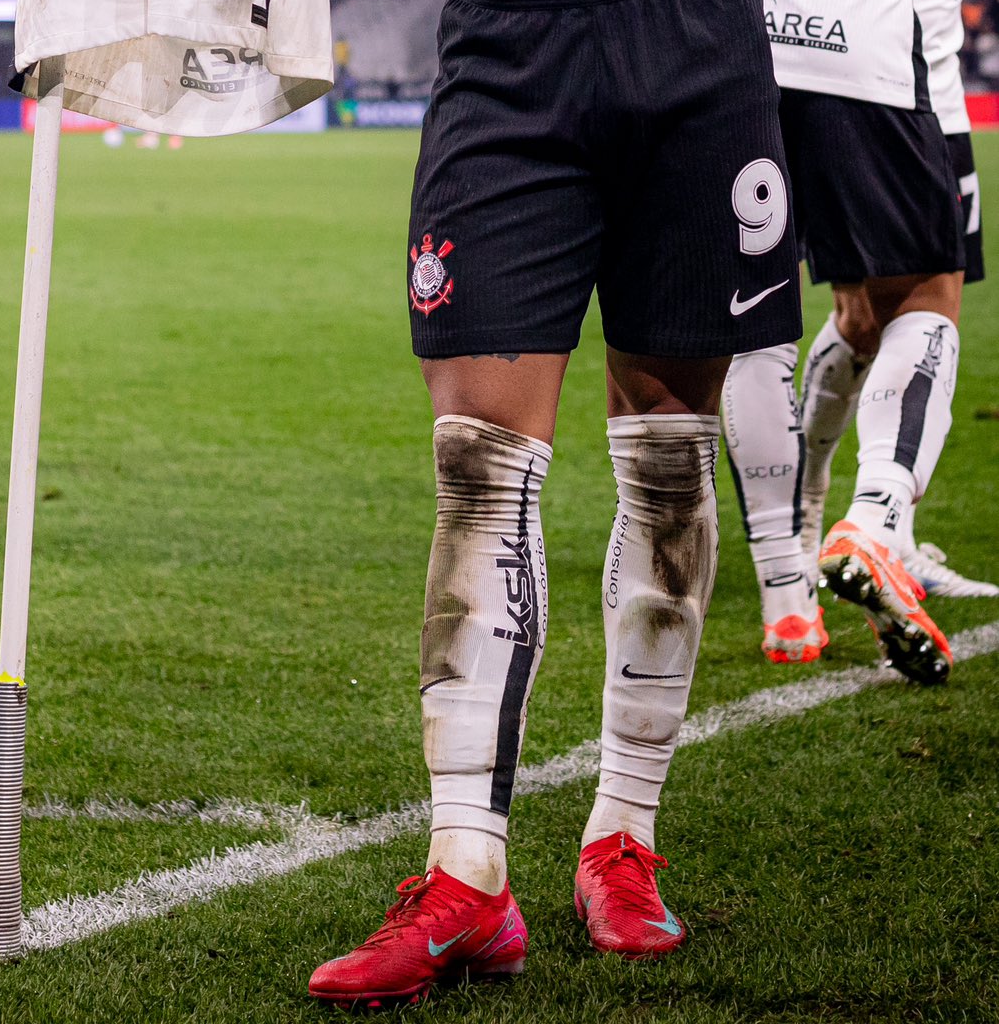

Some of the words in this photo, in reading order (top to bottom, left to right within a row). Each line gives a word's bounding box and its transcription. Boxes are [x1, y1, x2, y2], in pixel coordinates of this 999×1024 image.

[764, 10, 847, 43] AREA
[731, 158, 788, 255] 9
[744, 463, 793, 480] SCCP
